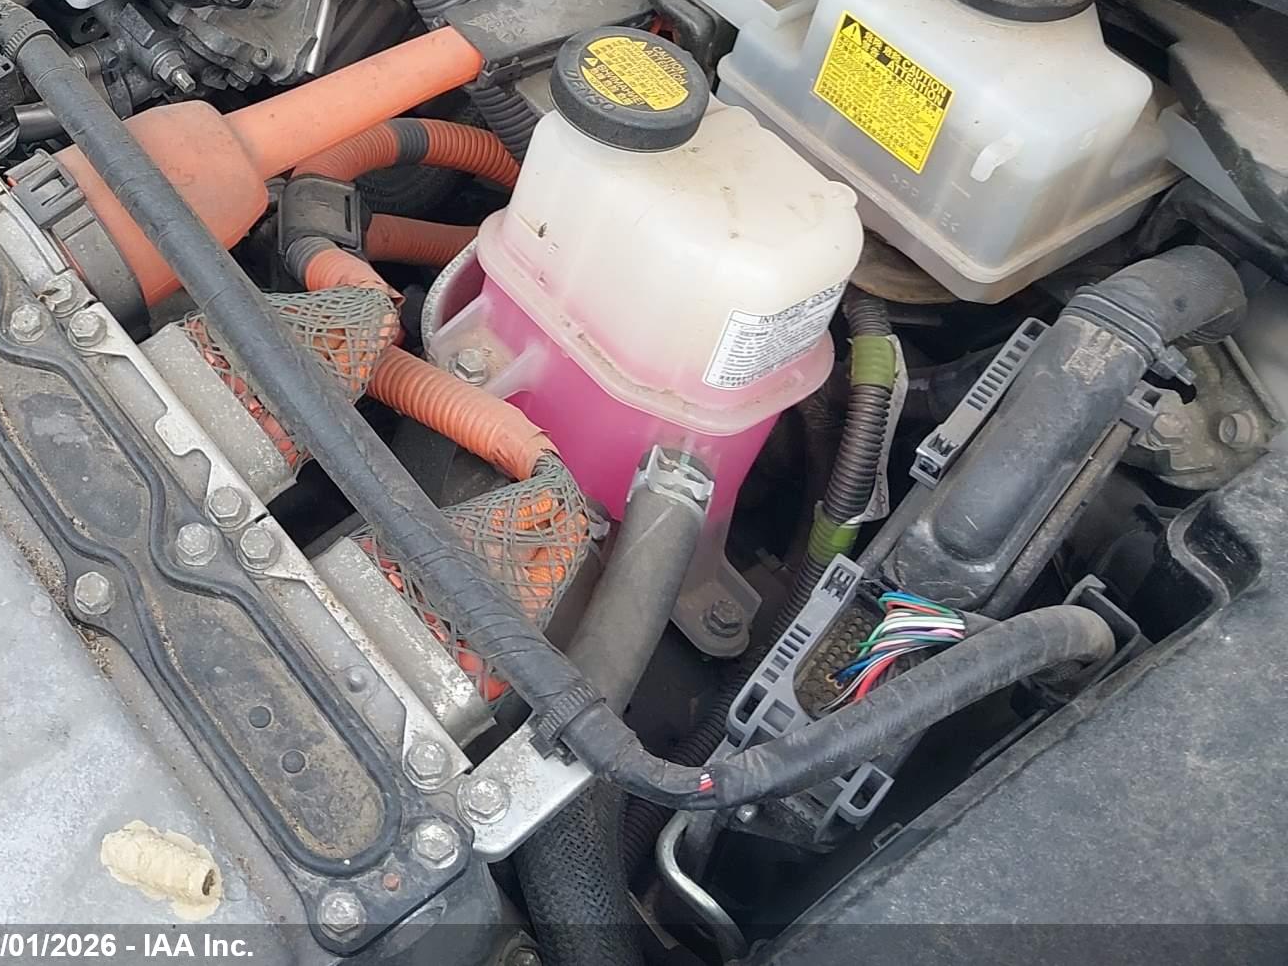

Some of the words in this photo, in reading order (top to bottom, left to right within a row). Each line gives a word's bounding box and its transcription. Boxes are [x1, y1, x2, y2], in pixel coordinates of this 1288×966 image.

[642, 47, 688, 86] ATTENTION
[650, 44, 687, 75] CAUTION
[900, 57, 948, 98] CAUTION
[564, 68, 616, 112] DENSO
[885, 58, 944, 107] ATTENTION
